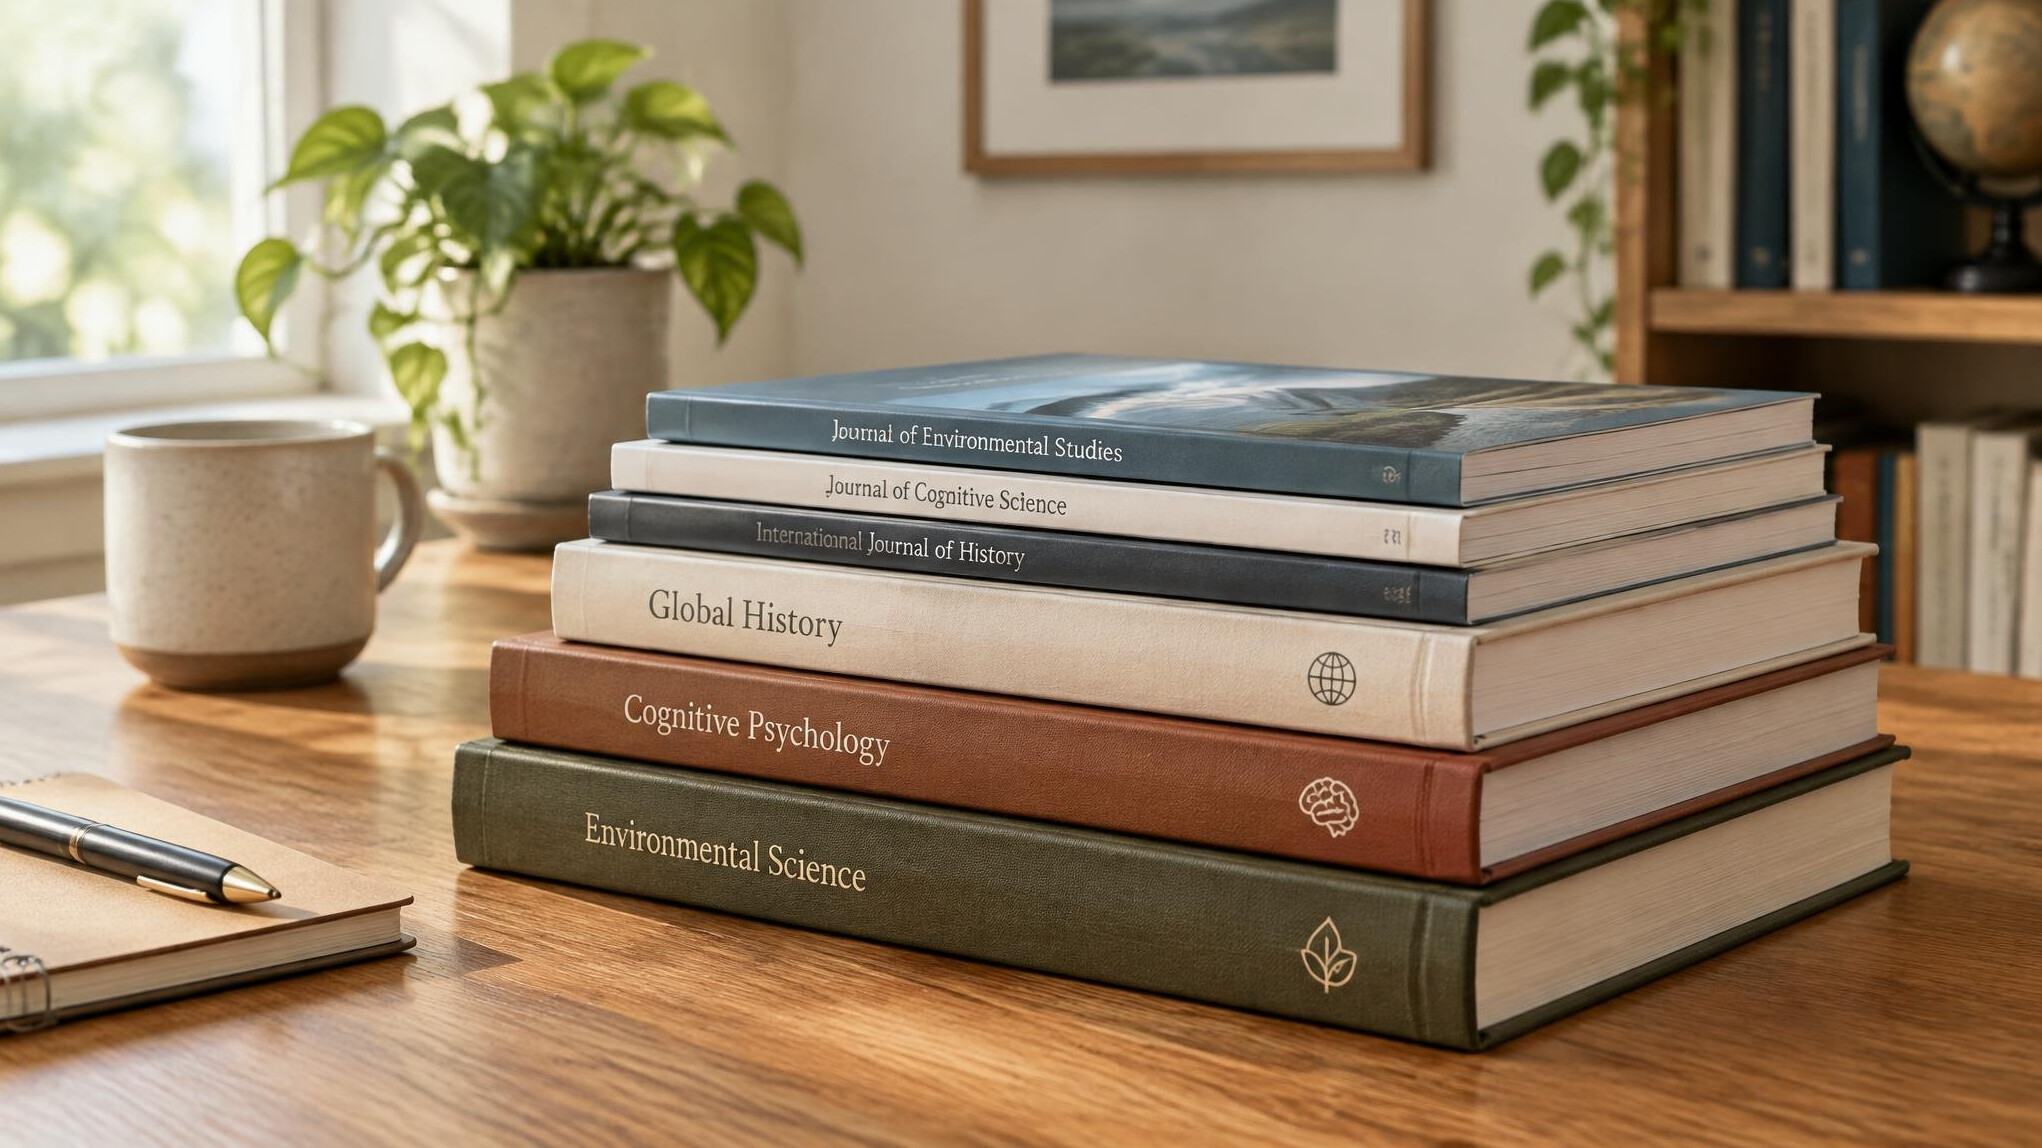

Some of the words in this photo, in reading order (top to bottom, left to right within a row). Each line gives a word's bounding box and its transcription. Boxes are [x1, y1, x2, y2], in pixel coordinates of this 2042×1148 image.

[832, 419, 894, 443] Journal
[899, 425, 919, 445] of
[922, 426, 1049, 456] Environmental
[1055, 437, 1123, 463] Studies
[825, 475, 887, 499] Journal
[893, 481, 911, 501] of
[915, 482, 995, 509] Cognitive
[999, 490, 1067, 516] Science
[866, 531, 929, 558] Journal
[935, 540, 954, 559] of
[958, 541, 1025, 572] History
[649, 589, 734, 628] Global
[742, 599, 843, 647] History
[624, 694, 740, 736] Cognitive
[748, 710, 891, 768] Psychology
[585, 812, 760, 873] Environmental
[768, 844, 868, 892] Science
